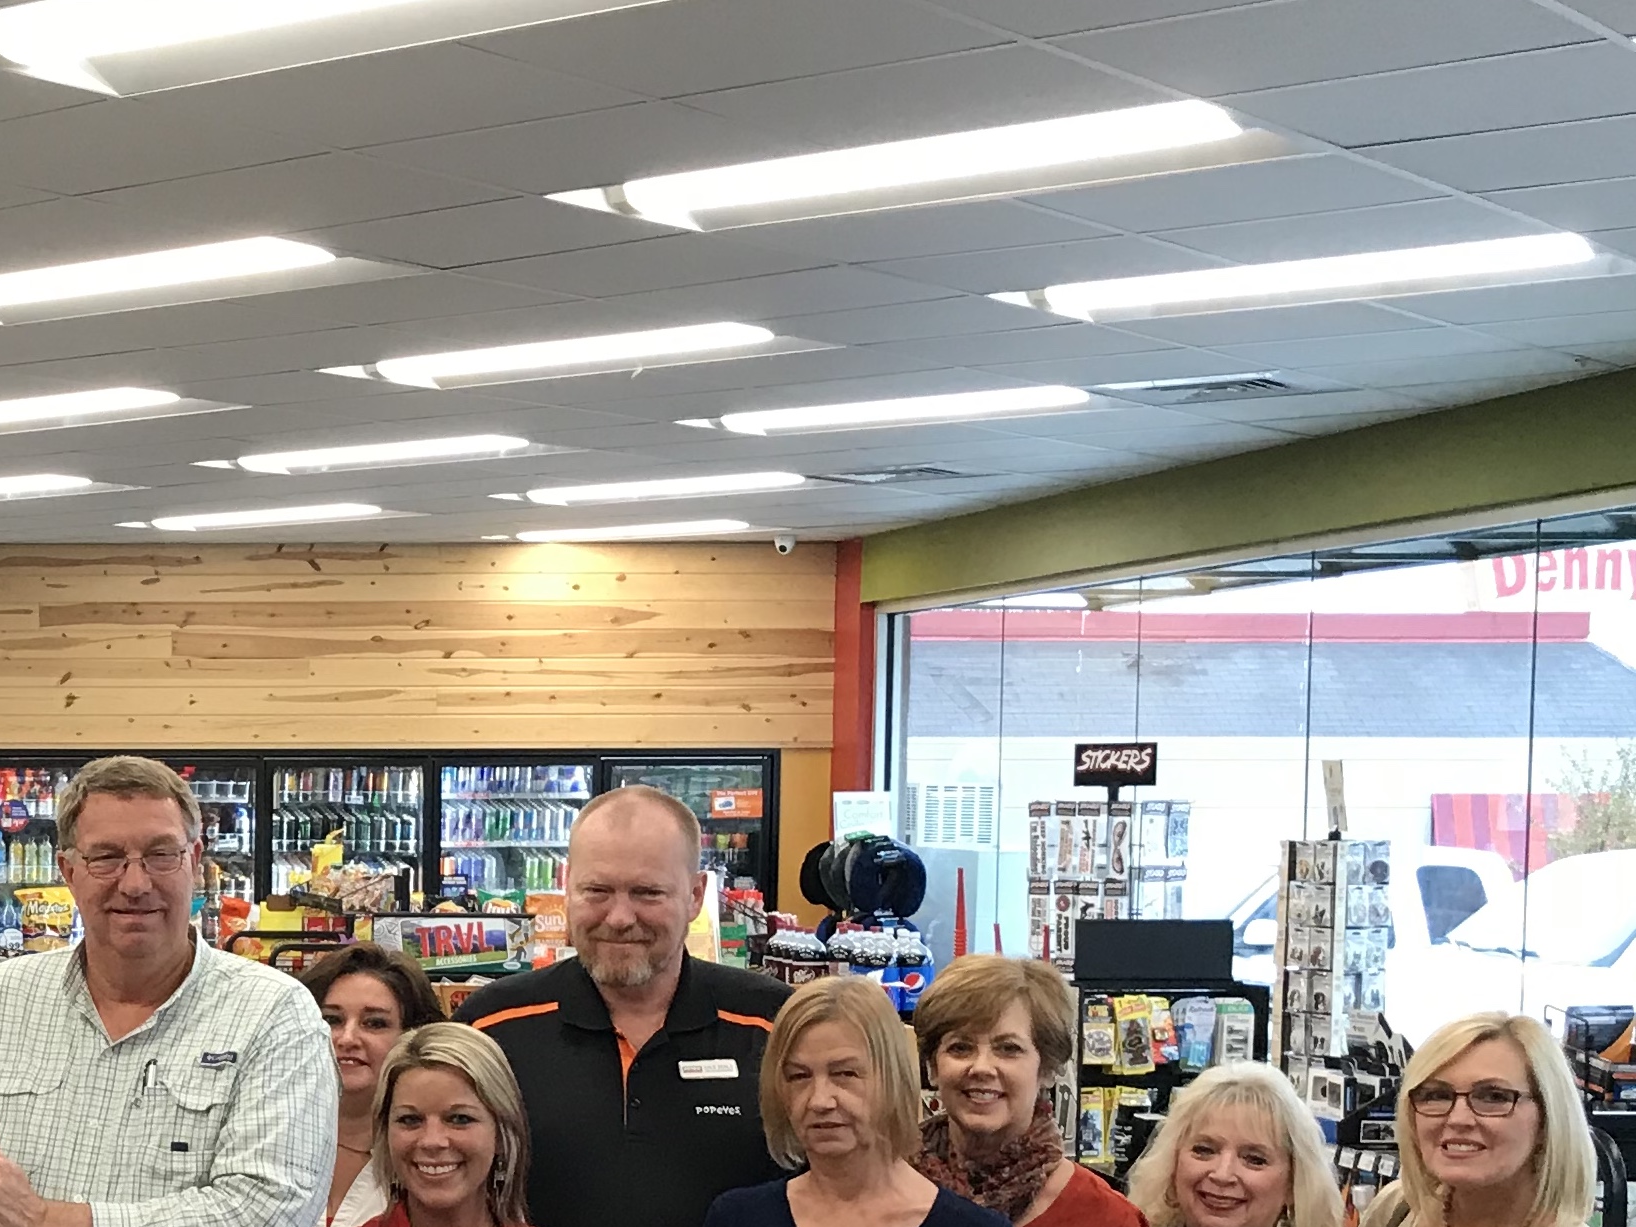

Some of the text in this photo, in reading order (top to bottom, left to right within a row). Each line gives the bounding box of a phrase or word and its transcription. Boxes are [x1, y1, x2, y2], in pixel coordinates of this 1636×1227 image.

[1077, 747, 1152, 772] STICKERS
[535, 913, 566, 933] Sun
[416, 921, 495, 959] TRVL
[435, 953, 477, 966] ACCESSORIES
